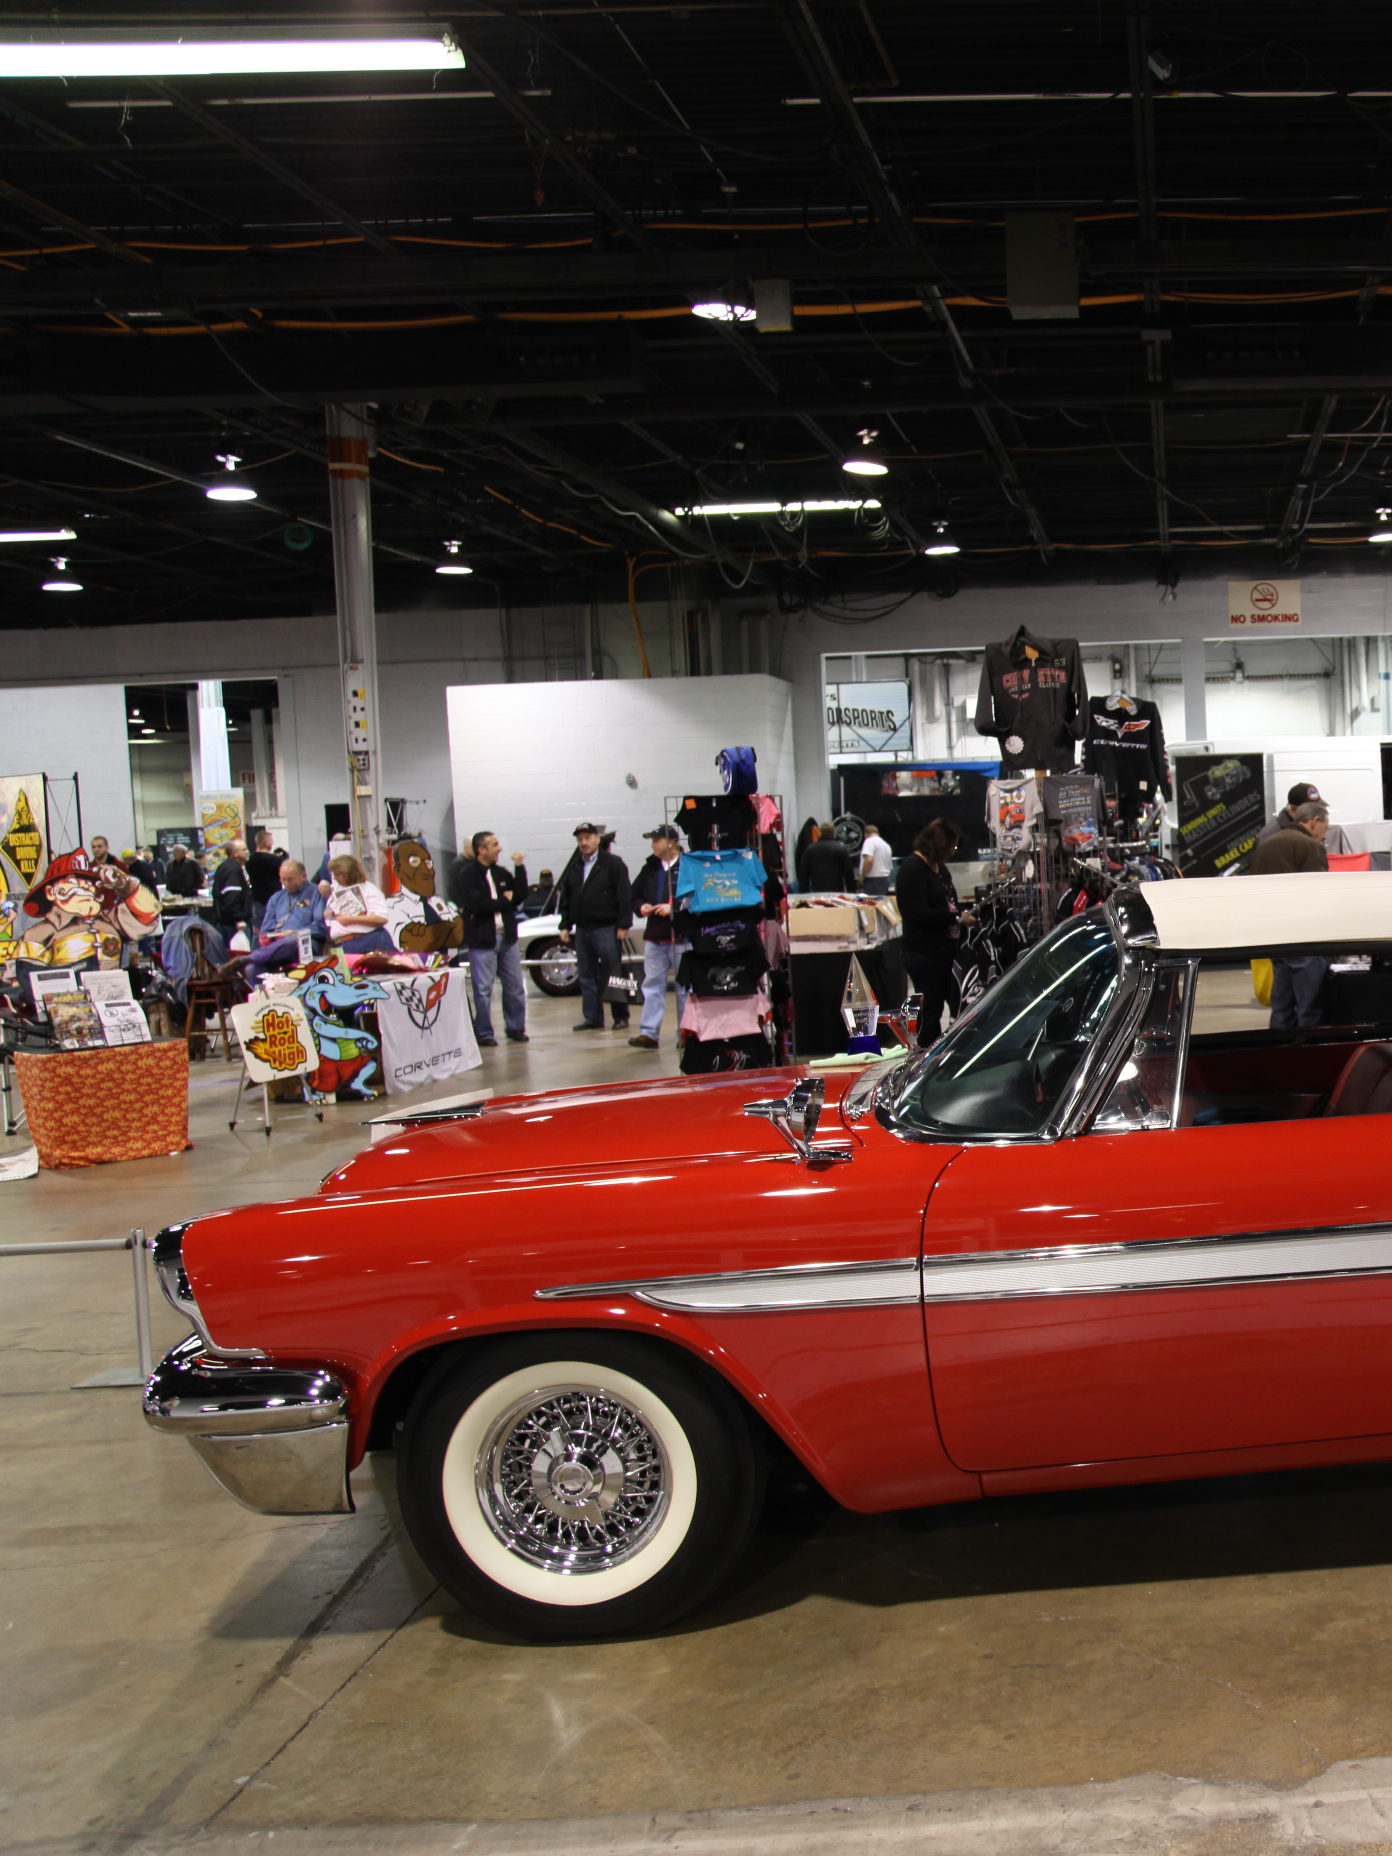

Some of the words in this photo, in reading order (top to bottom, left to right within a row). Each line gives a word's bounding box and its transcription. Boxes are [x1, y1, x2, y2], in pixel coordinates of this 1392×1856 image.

[1230, 614, 1246, 624] NO
[1250, 613, 1300, 624] SMOKING
[1054, 658, 1066, 668] 53
[1093, 739, 1148, 749] CORVETTE
[1180, 814, 1208, 835] SENDING
[1205, 802, 1227, 819] UNITS
[1184, 818, 1218, 844] MASTER
[1216, 790, 1261, 824] CYLINDERS
[9, 832, 40, 847] DISTRACTED
[16, 845, 38, 860] DRIVING
[1214, 846, 1241, 868] BRAKE
[20, 859, 36, 873] KILLS
[265, 1013, 292, 1033] Hot
[268, 1027, 297, 1049] Rod
[265, 1045, 305, 1068] High
[394, 1047, 464, 1079] CORVETTE
